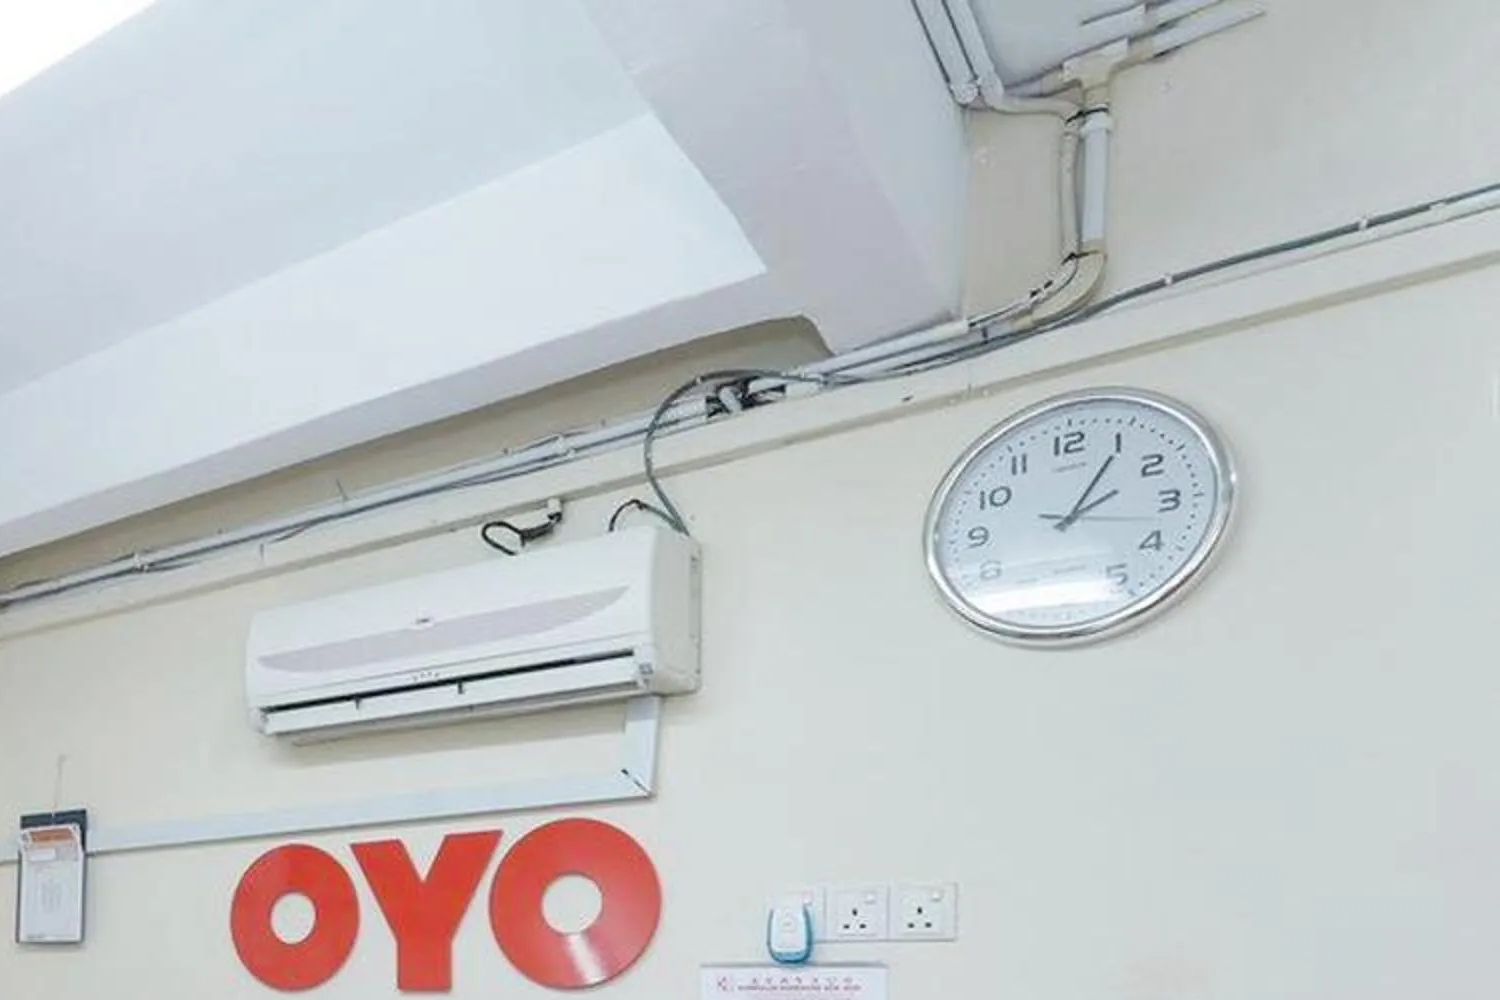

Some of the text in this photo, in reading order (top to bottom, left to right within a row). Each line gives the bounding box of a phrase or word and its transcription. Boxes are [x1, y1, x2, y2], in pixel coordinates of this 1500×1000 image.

[1053, 431, 1086, 456] 12
[1115, 432, 1122, 454] 1
[1011, 453, 1027, 476] 11
[1141, 453, 1165, 478] 2
[979, 485, 1013, 510] 10
[1158, 489, 1181, 512] 3
[967, 526, 990, 548] 9
[1138, 530, 1163, 550] 4
[1106, 563, 1128, 586] 5
[230, 817, 662, 993] OYO
